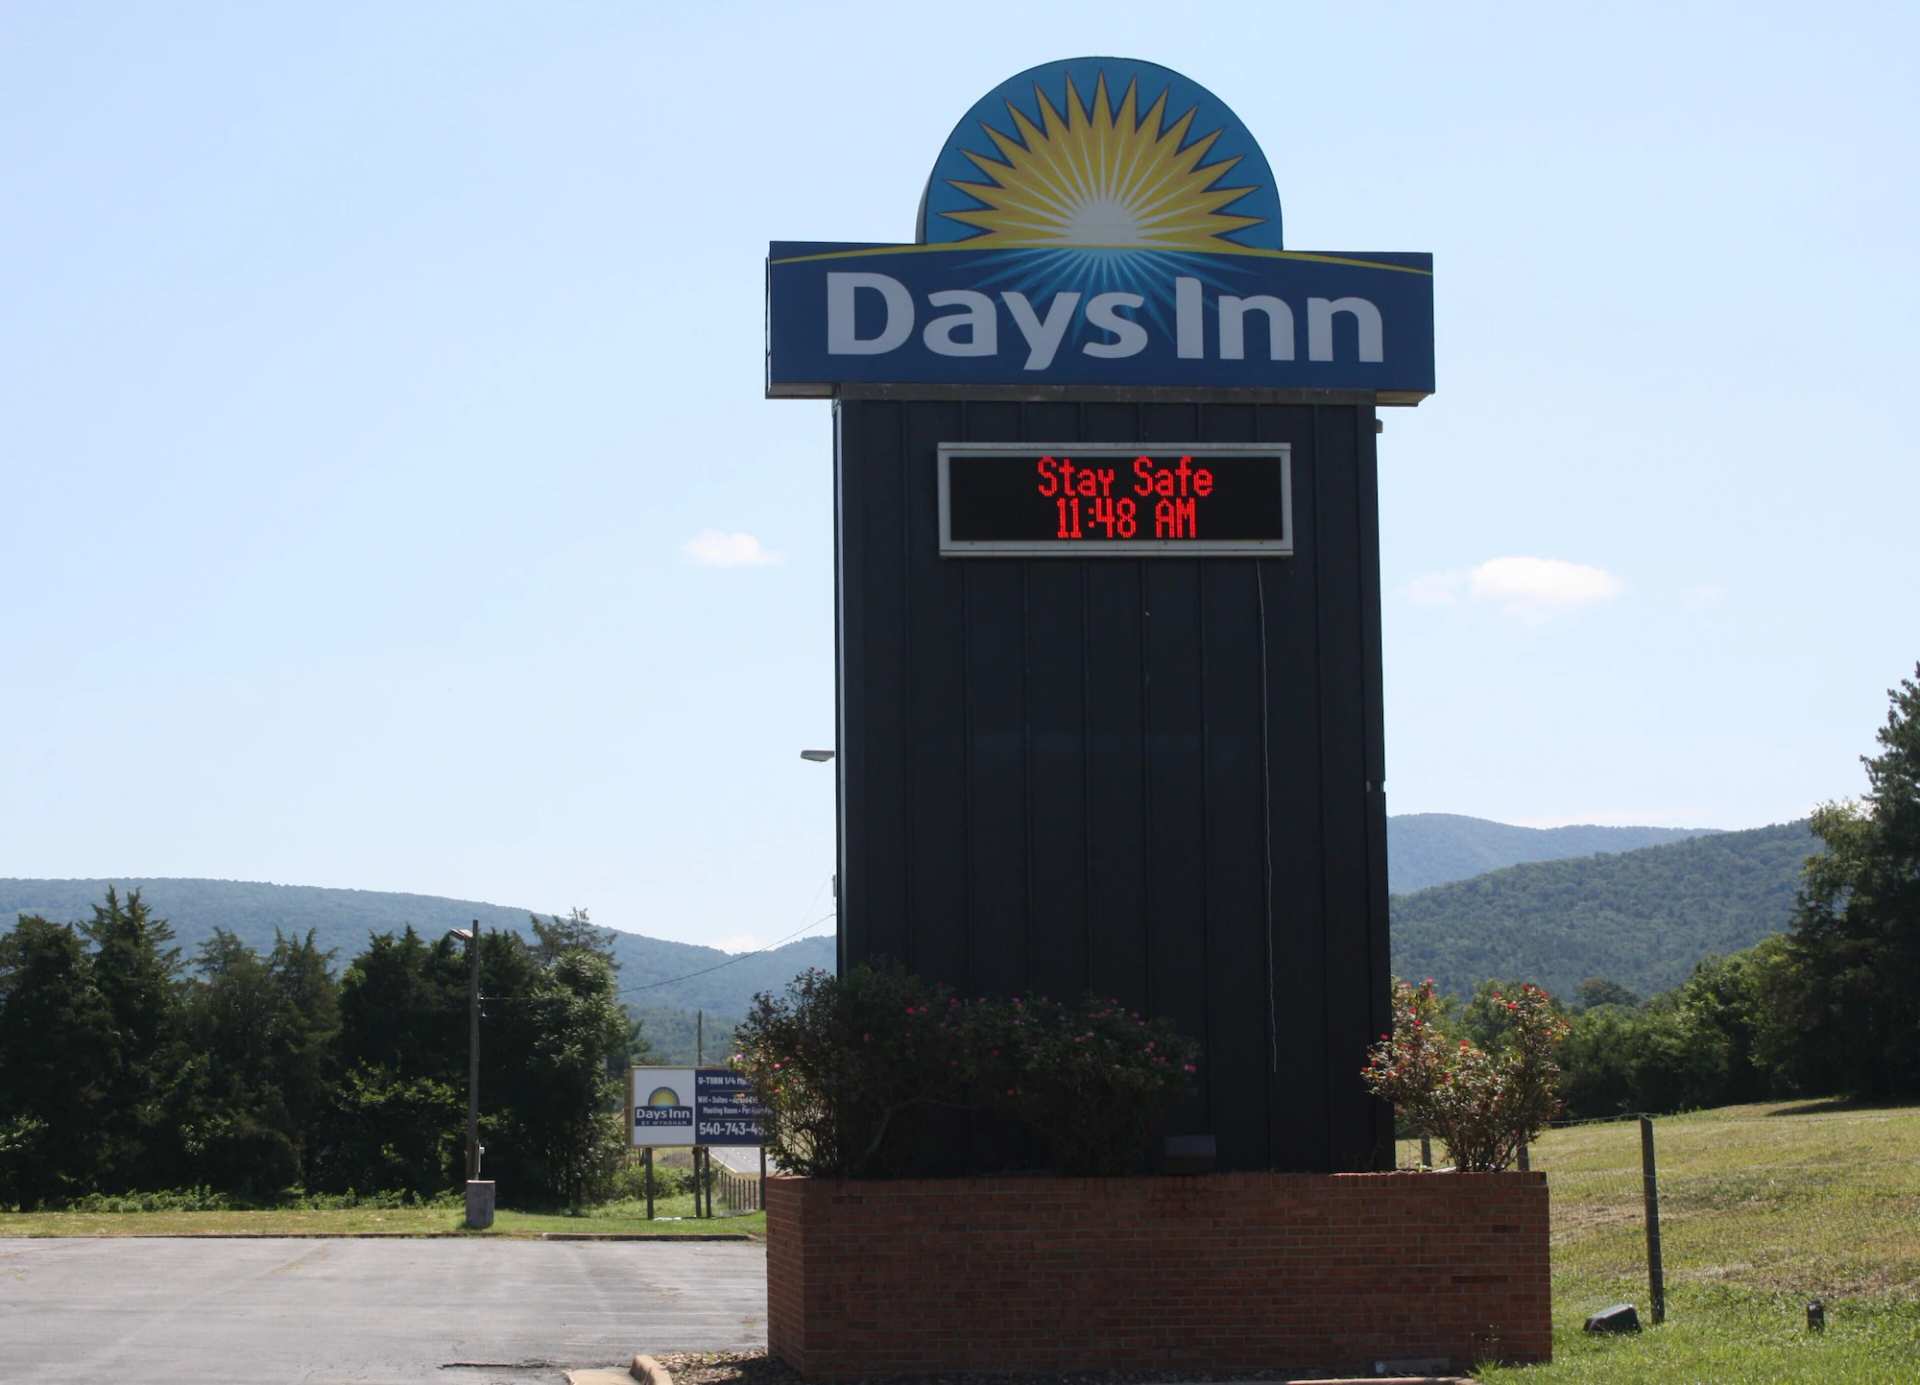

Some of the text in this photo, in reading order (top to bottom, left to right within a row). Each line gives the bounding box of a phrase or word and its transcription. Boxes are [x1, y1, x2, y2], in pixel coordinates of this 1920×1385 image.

[826, 271, 1384, 371] Days Inn
[1037, 455, 1214, 497] Stay Safe
[1056, 498, 1197, 539] 11:48 AM
[636, 1108, 690, 1120] Days Inn
